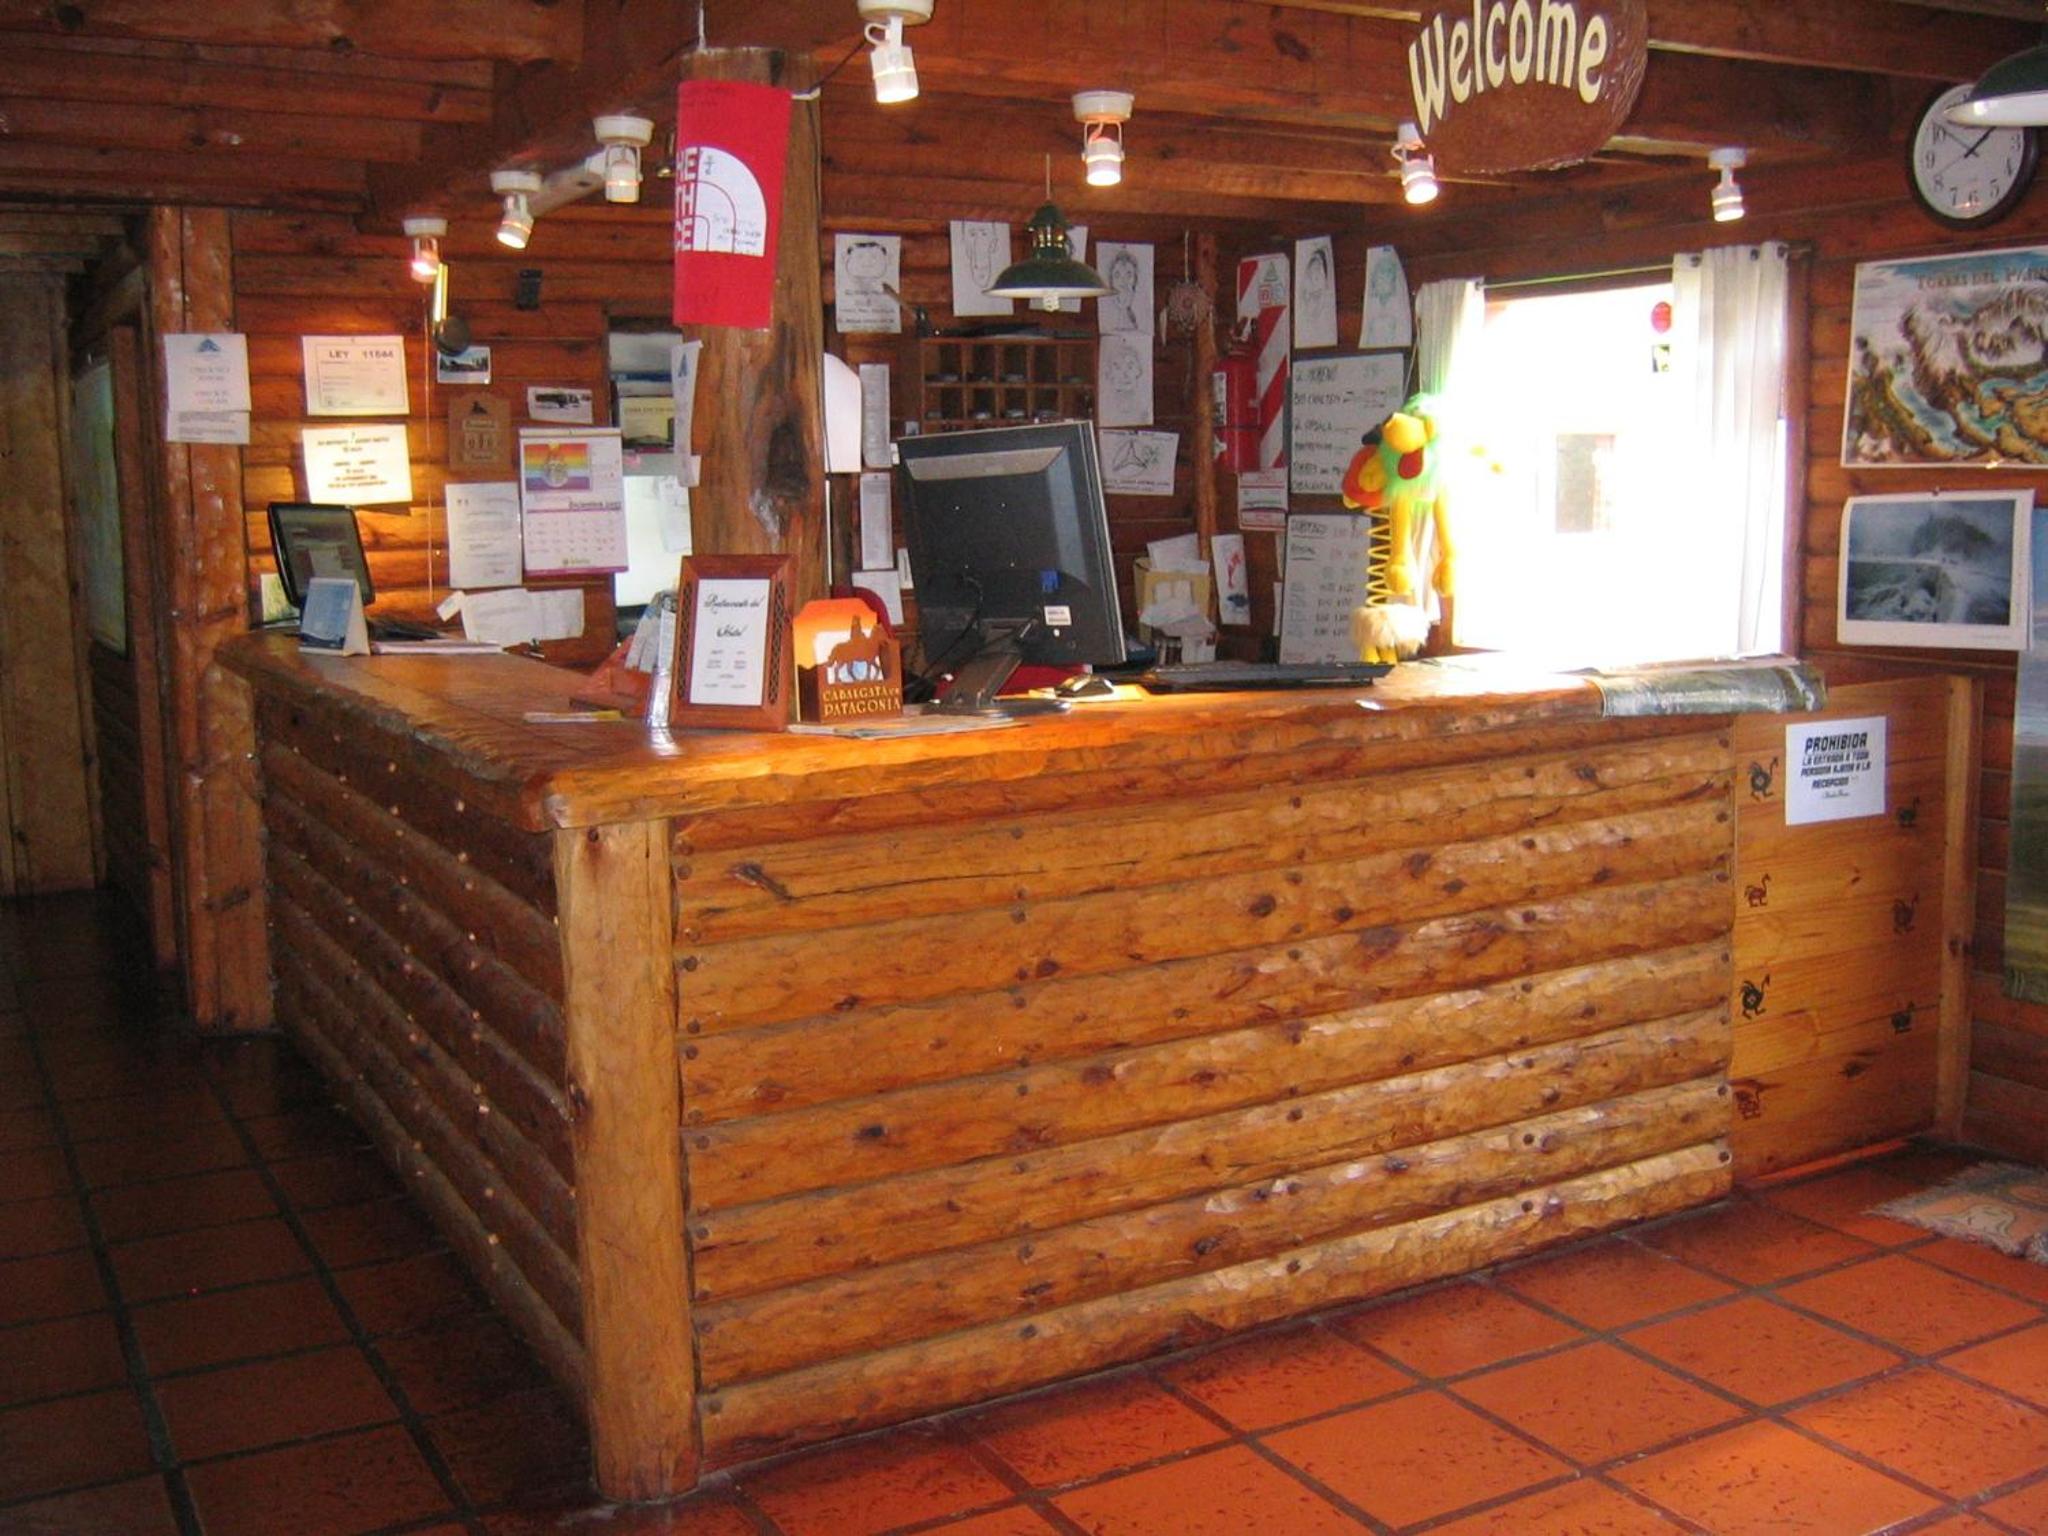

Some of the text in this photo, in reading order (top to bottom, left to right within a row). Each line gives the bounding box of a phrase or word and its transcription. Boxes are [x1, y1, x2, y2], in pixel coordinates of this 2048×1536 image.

[1408, 0, 1608, 136] Welcome
[1928, 121, 1946, 145] 10
[1925, 153, 1936, 169] 9
[1933, 174, 1945, 192] 8
[1951, 187, 1959, 206] 7
[329, 350, 350, 359] LEY
[823, 686, 887, 702] CABALGATA
[824, 698, 901, 717] PATAGONIA
